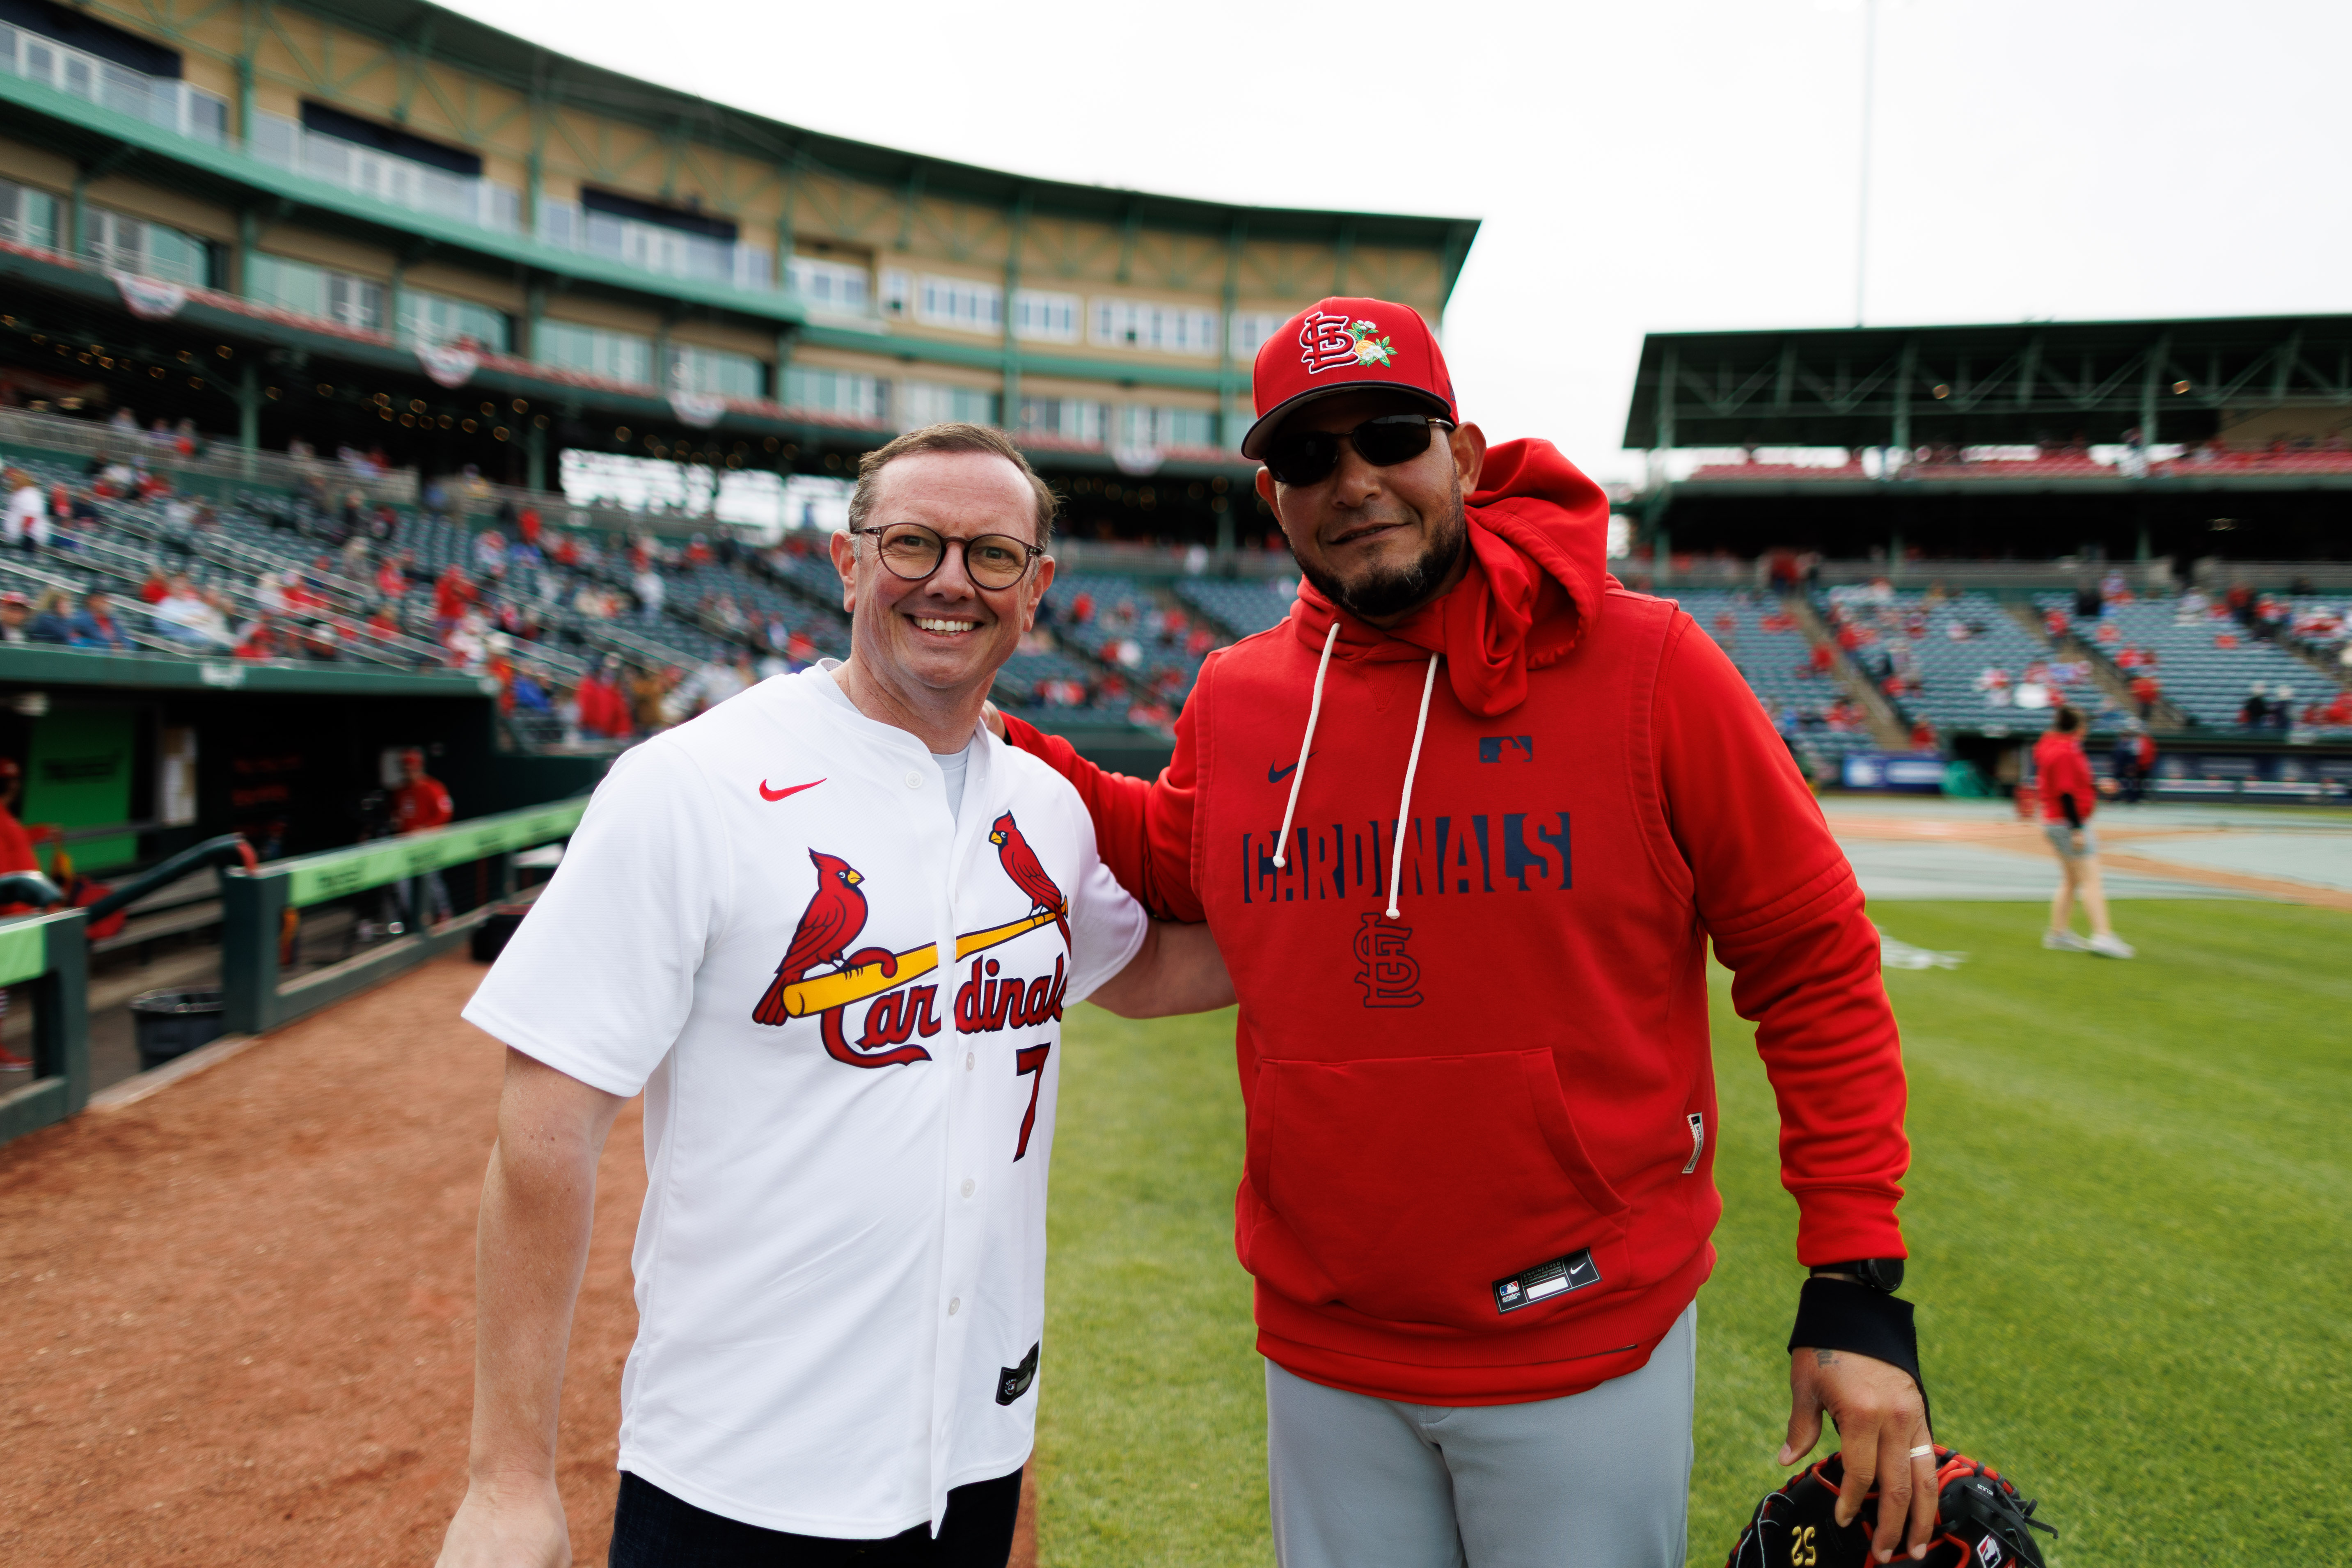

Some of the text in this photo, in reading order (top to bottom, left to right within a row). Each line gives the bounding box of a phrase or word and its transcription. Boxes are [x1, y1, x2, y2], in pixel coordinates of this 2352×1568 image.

[1243, 811, 1573, 904] CARDINALS
[1013, 1042, 1051, 1163] 7
[1523, 1261, 1560, 1277] ENGINEERED
